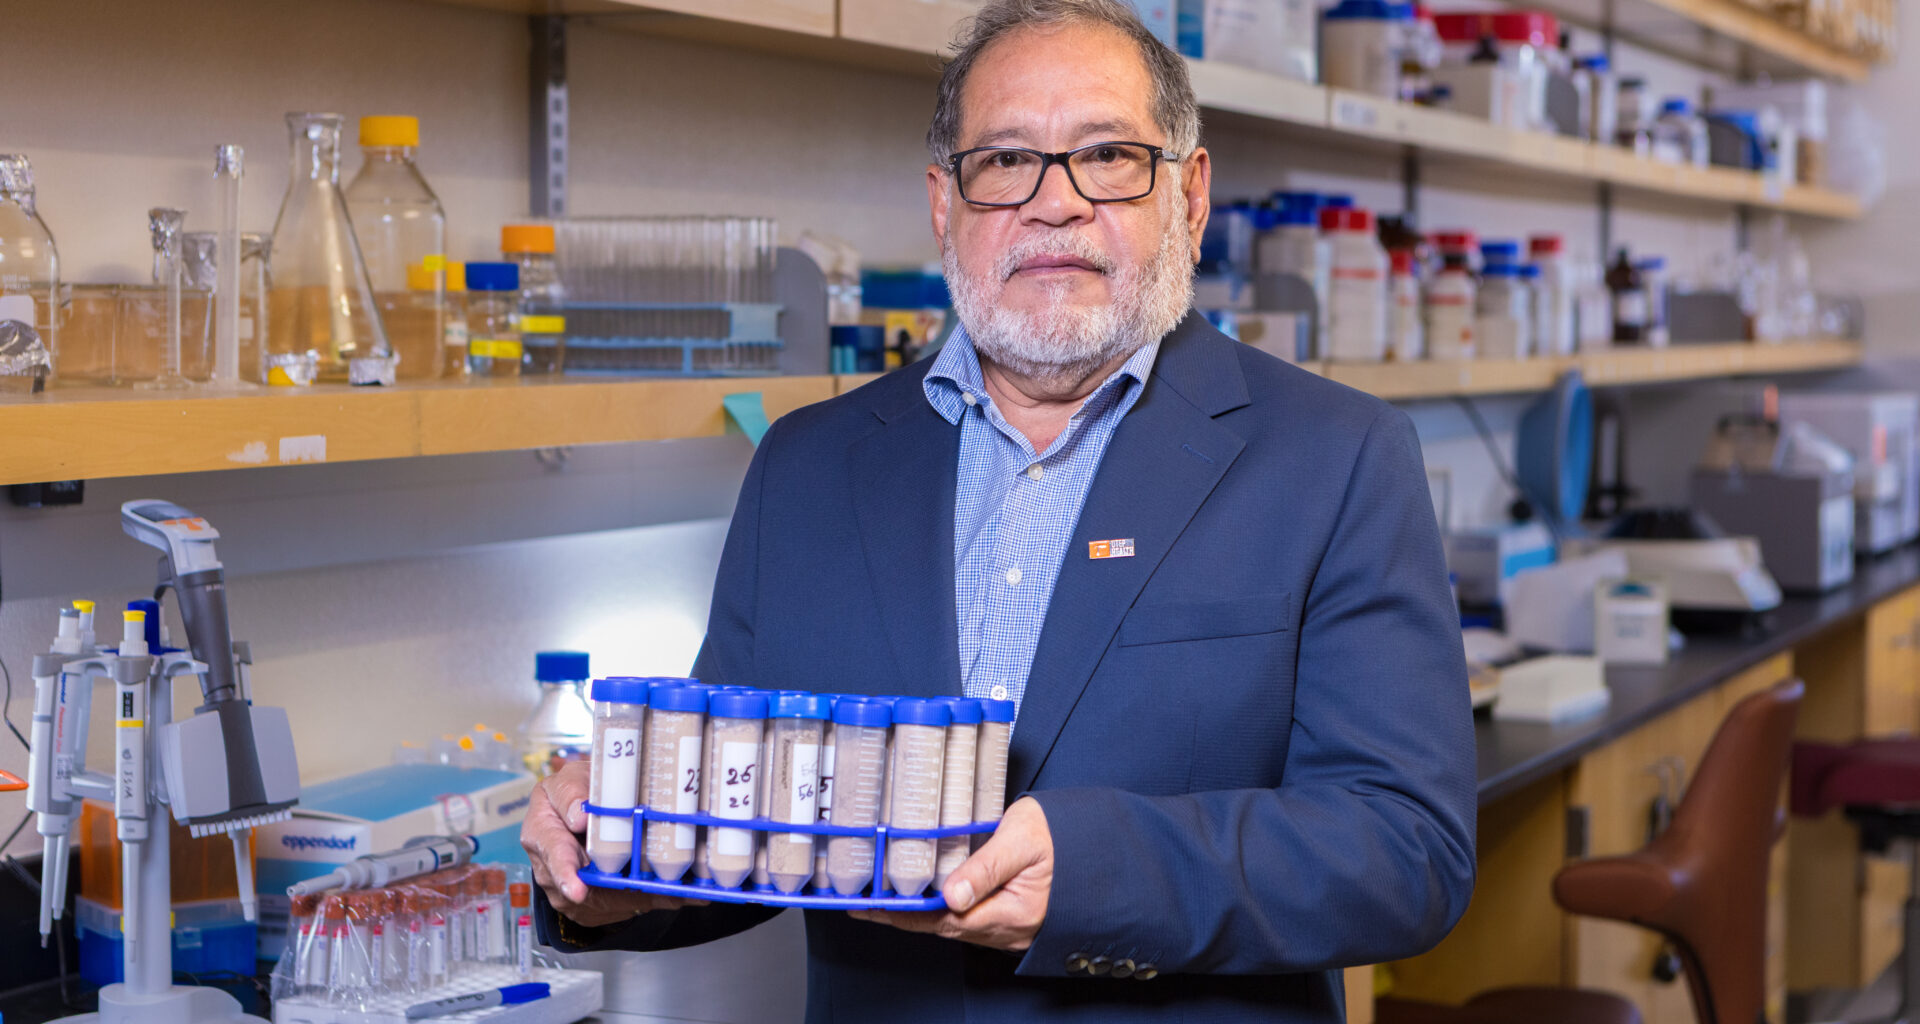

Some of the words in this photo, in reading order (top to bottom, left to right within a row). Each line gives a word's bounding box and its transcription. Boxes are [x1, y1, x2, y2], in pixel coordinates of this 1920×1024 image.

[608, 739, 635, 759] 32
[726, 763, 756, 786] 26
[798, 783, 814, 801] 56
[729, 795, 749, 809] 26
[281, 834, 356, 851] eppendorf
